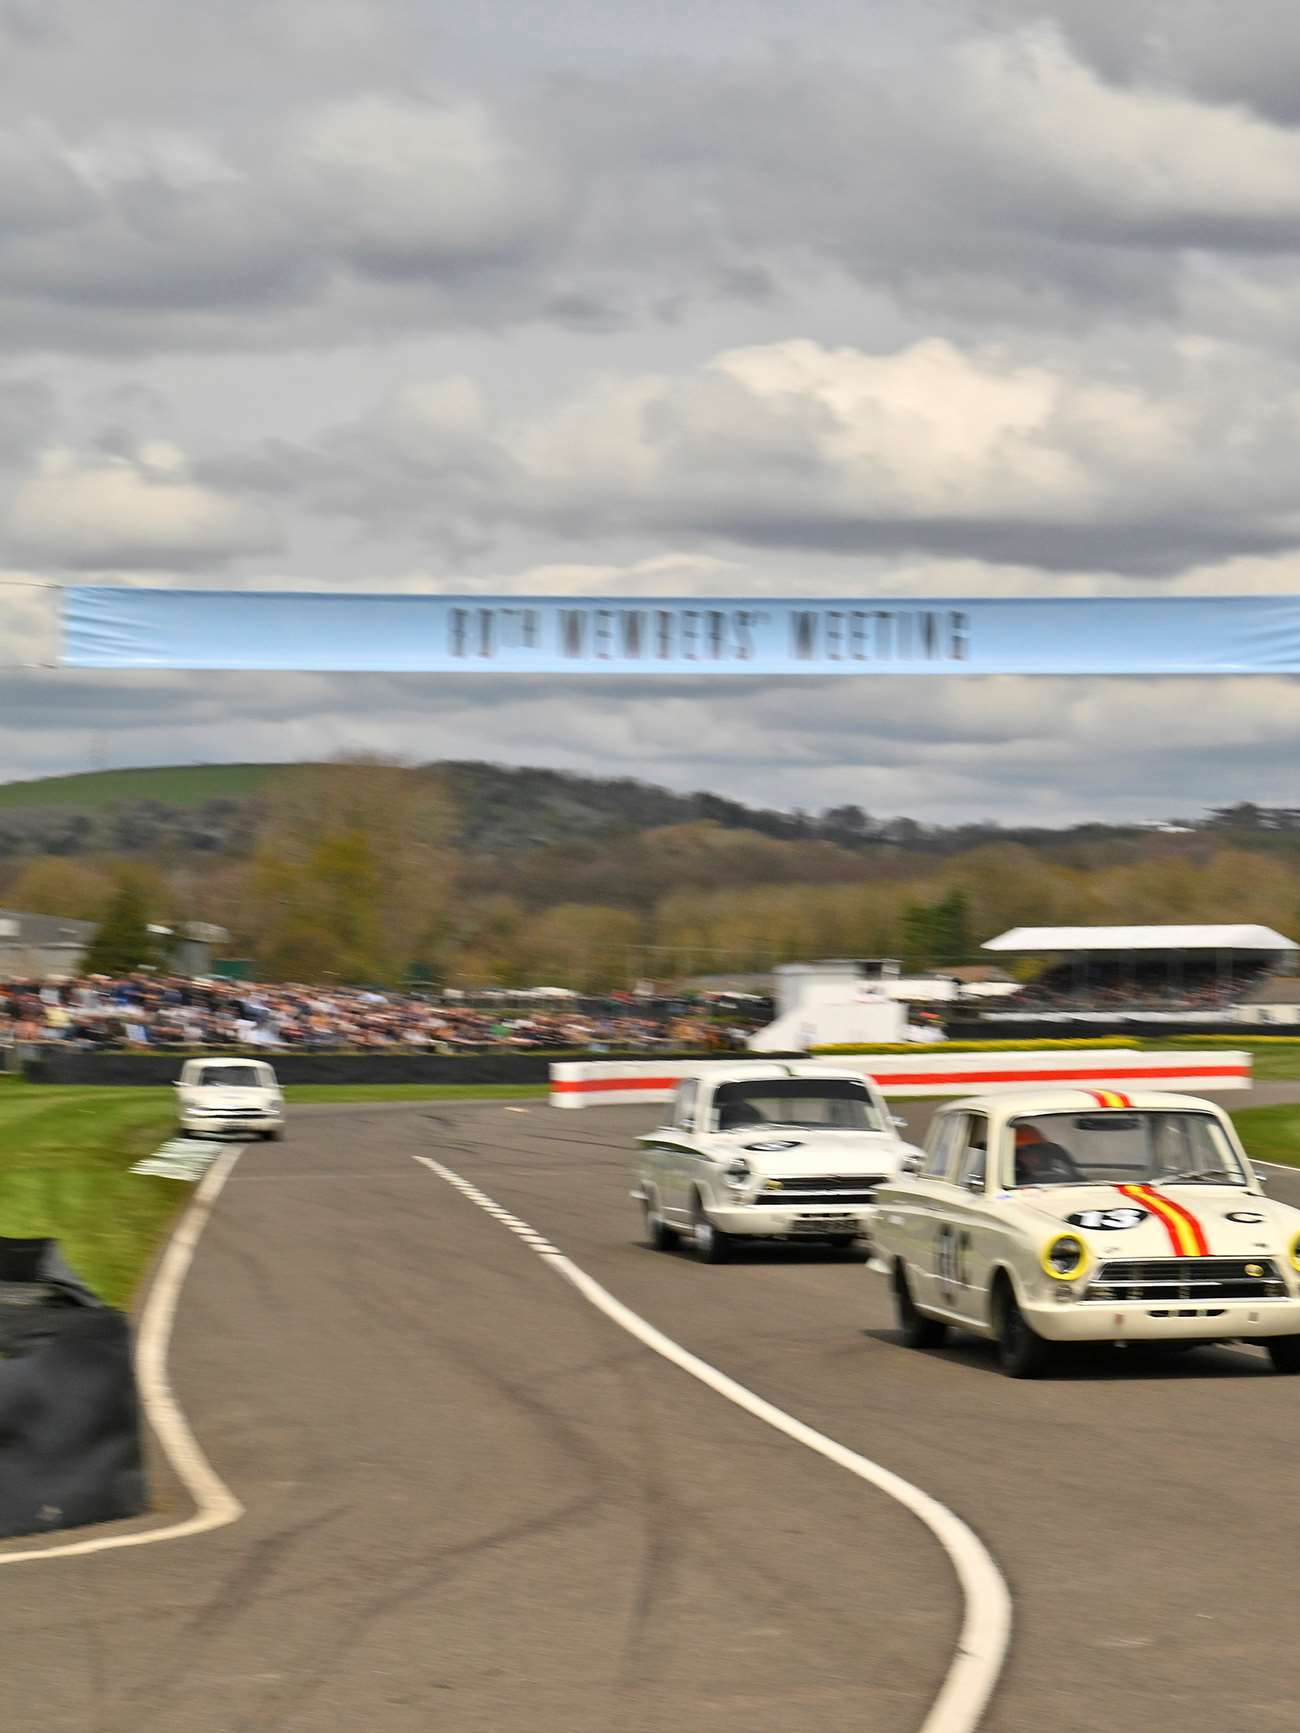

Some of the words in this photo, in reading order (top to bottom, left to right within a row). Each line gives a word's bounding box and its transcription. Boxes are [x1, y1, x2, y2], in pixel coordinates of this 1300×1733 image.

[790, 610, 970, 662] MEETING
[1079, 1207, 1142, 1229] 13
[1224, 1211, 1265, 1225] C
